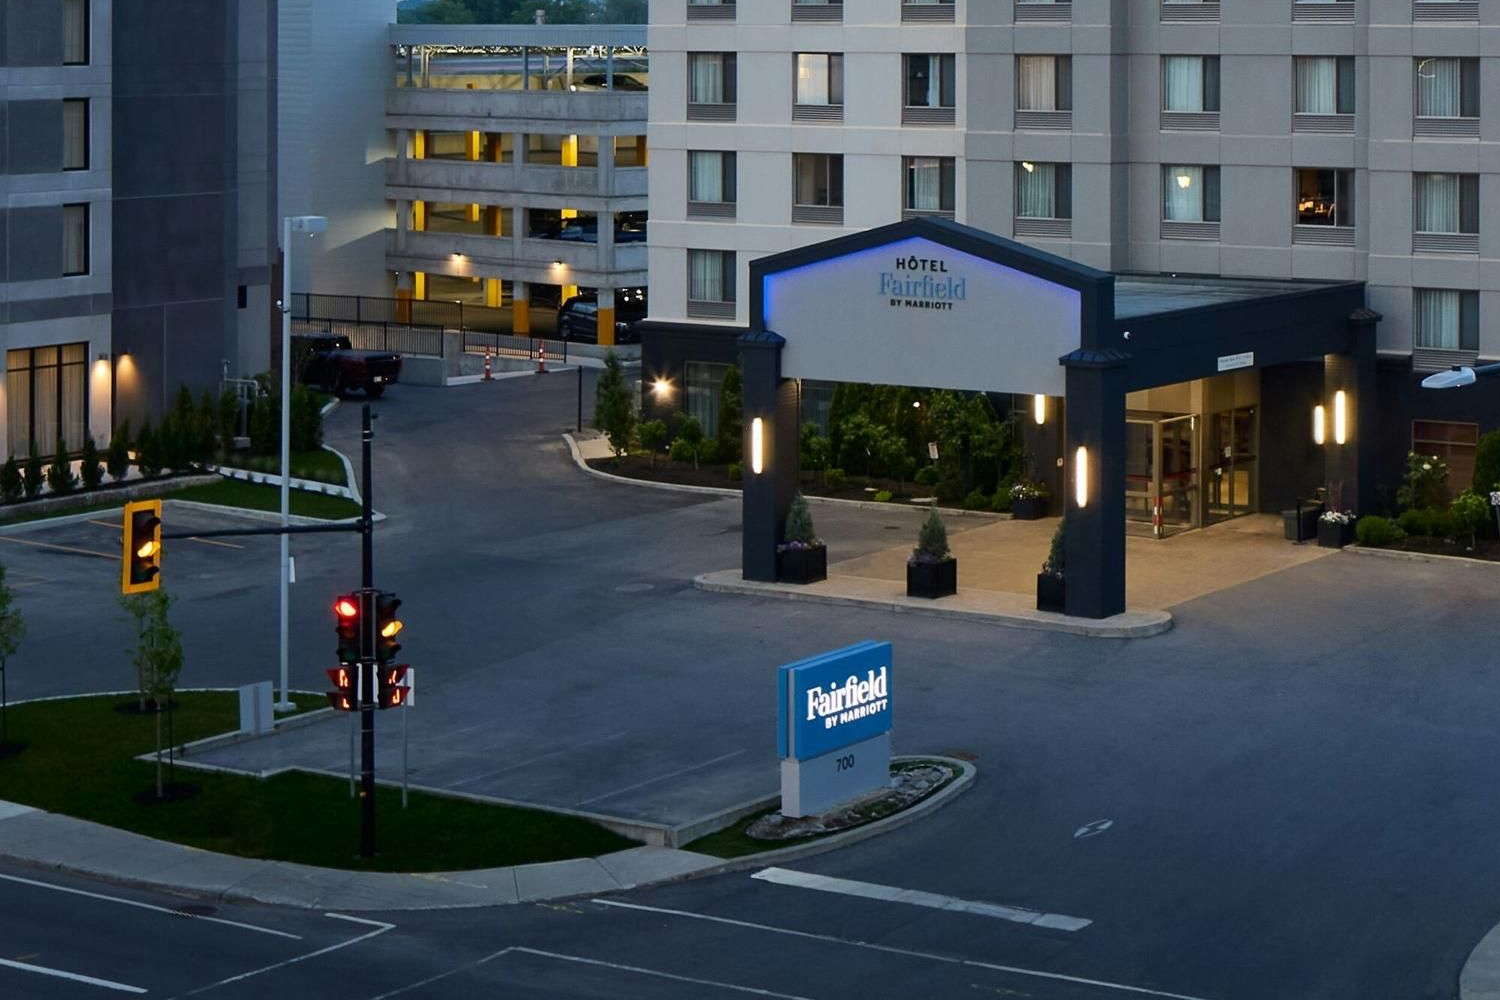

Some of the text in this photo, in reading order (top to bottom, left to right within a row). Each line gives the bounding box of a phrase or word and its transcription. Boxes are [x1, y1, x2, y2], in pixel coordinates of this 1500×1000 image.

[895, 255, 949, 273] HÔTEL
[878, 271, 967, 301] Fairfield
[890, 298, 953, 311] BY MARRIOTT
[806, 665, 888, 721] Fairfield
[825, 698, 888, 730] BY MARRIOTT
[835, 754, 855, 773] 700
